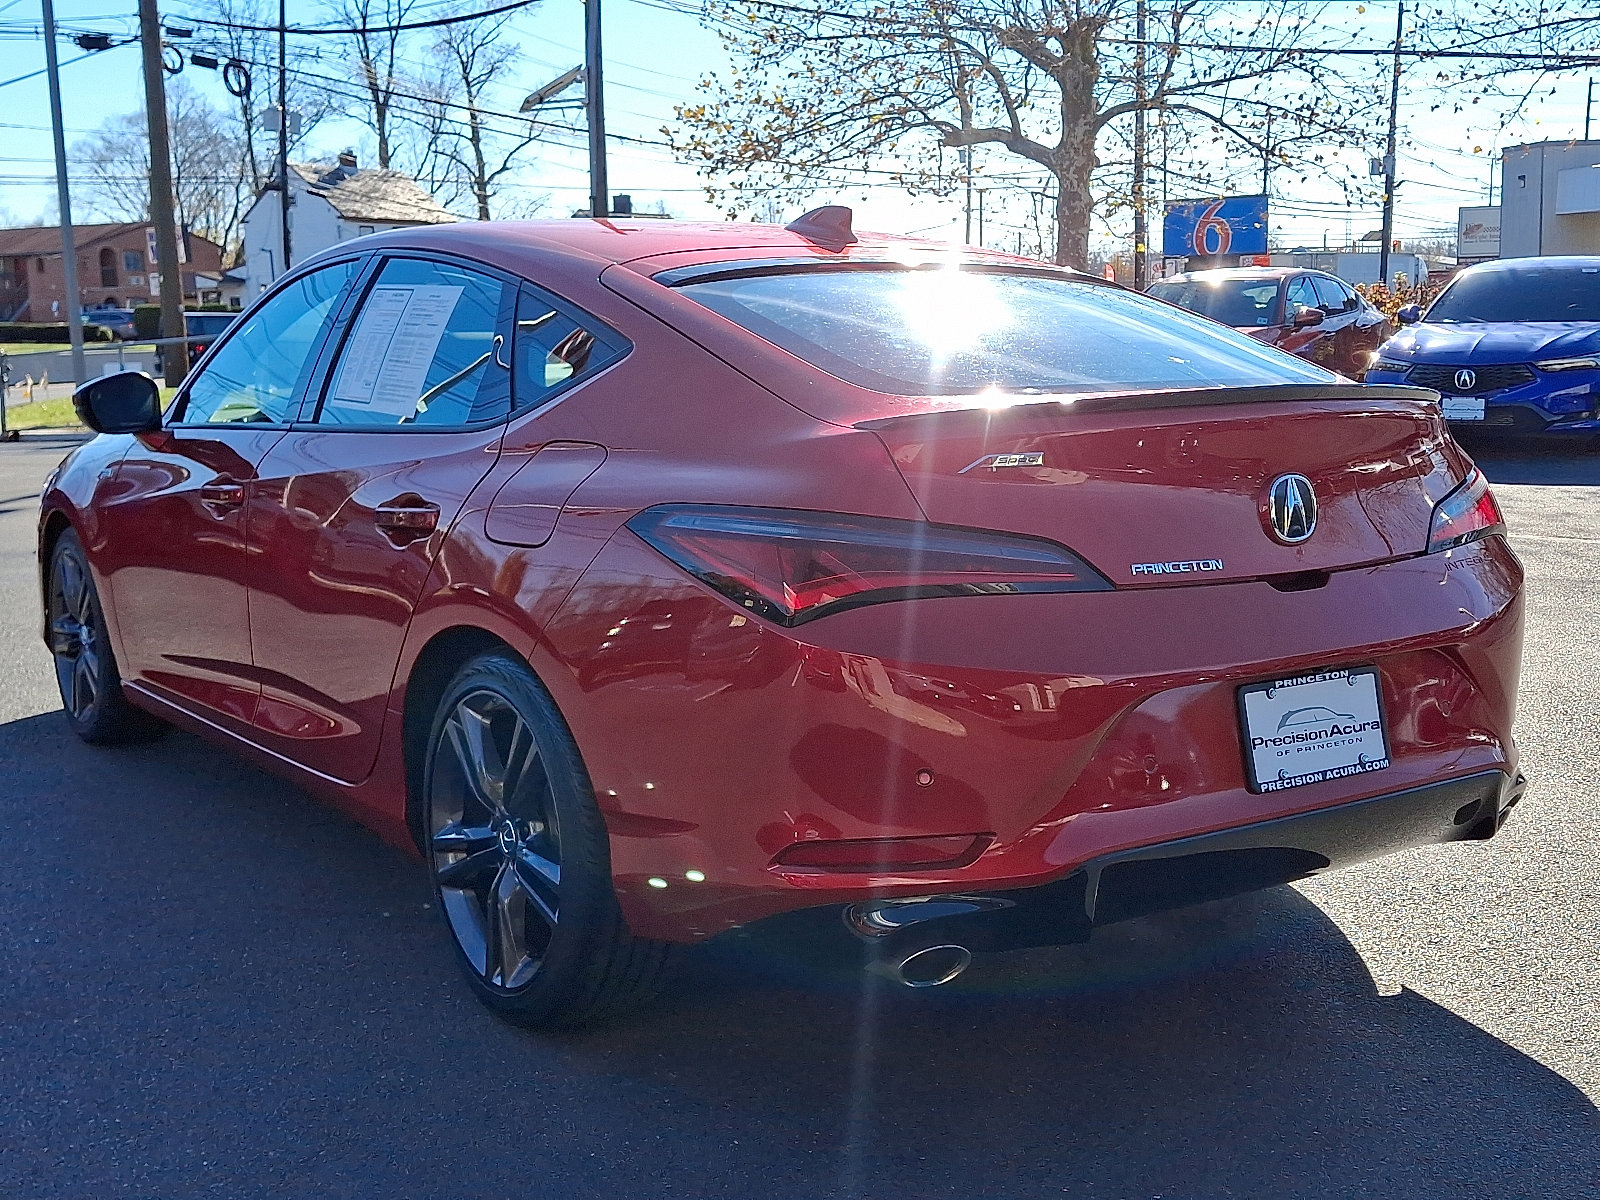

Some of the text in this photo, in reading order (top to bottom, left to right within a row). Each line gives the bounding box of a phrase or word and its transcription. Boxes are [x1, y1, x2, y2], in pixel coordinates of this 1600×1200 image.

[1193, 200, 1232, 256] 6
[1130, 559, 1223, 576] PRINCETON
[1275, 670, 1349, 688] PRINCETON
[1296, 737, 1363, 754] PRINCETON
[1260, 759, 1390, 793] PRECISION ACURA.COM
